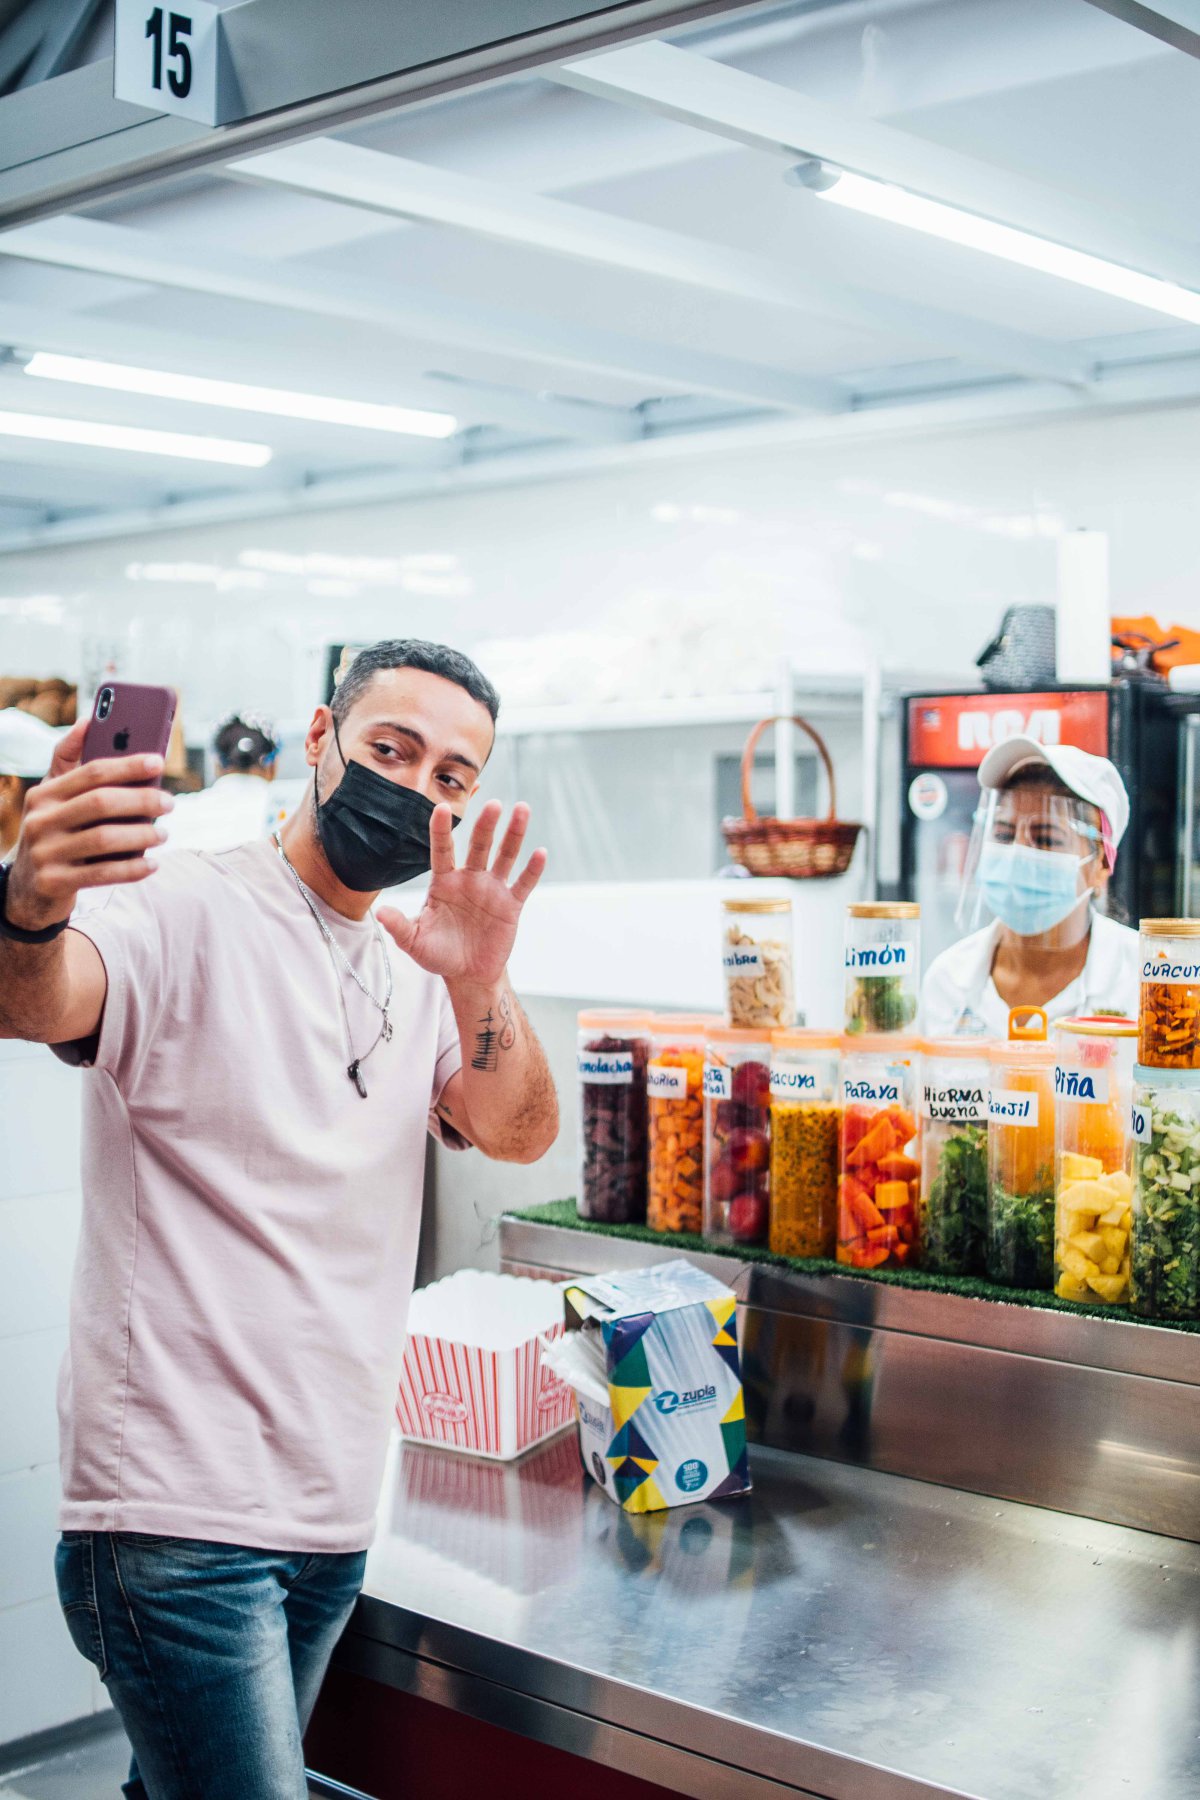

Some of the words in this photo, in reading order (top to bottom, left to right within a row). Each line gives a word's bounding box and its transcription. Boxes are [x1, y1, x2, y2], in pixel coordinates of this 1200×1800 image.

[145, 6, 192, 99] 15
[957, 709, 1060, 750] RCA
[1055, 1066, 1096, 1099] Piña
[682, 1385, 716, 1401] zupla
